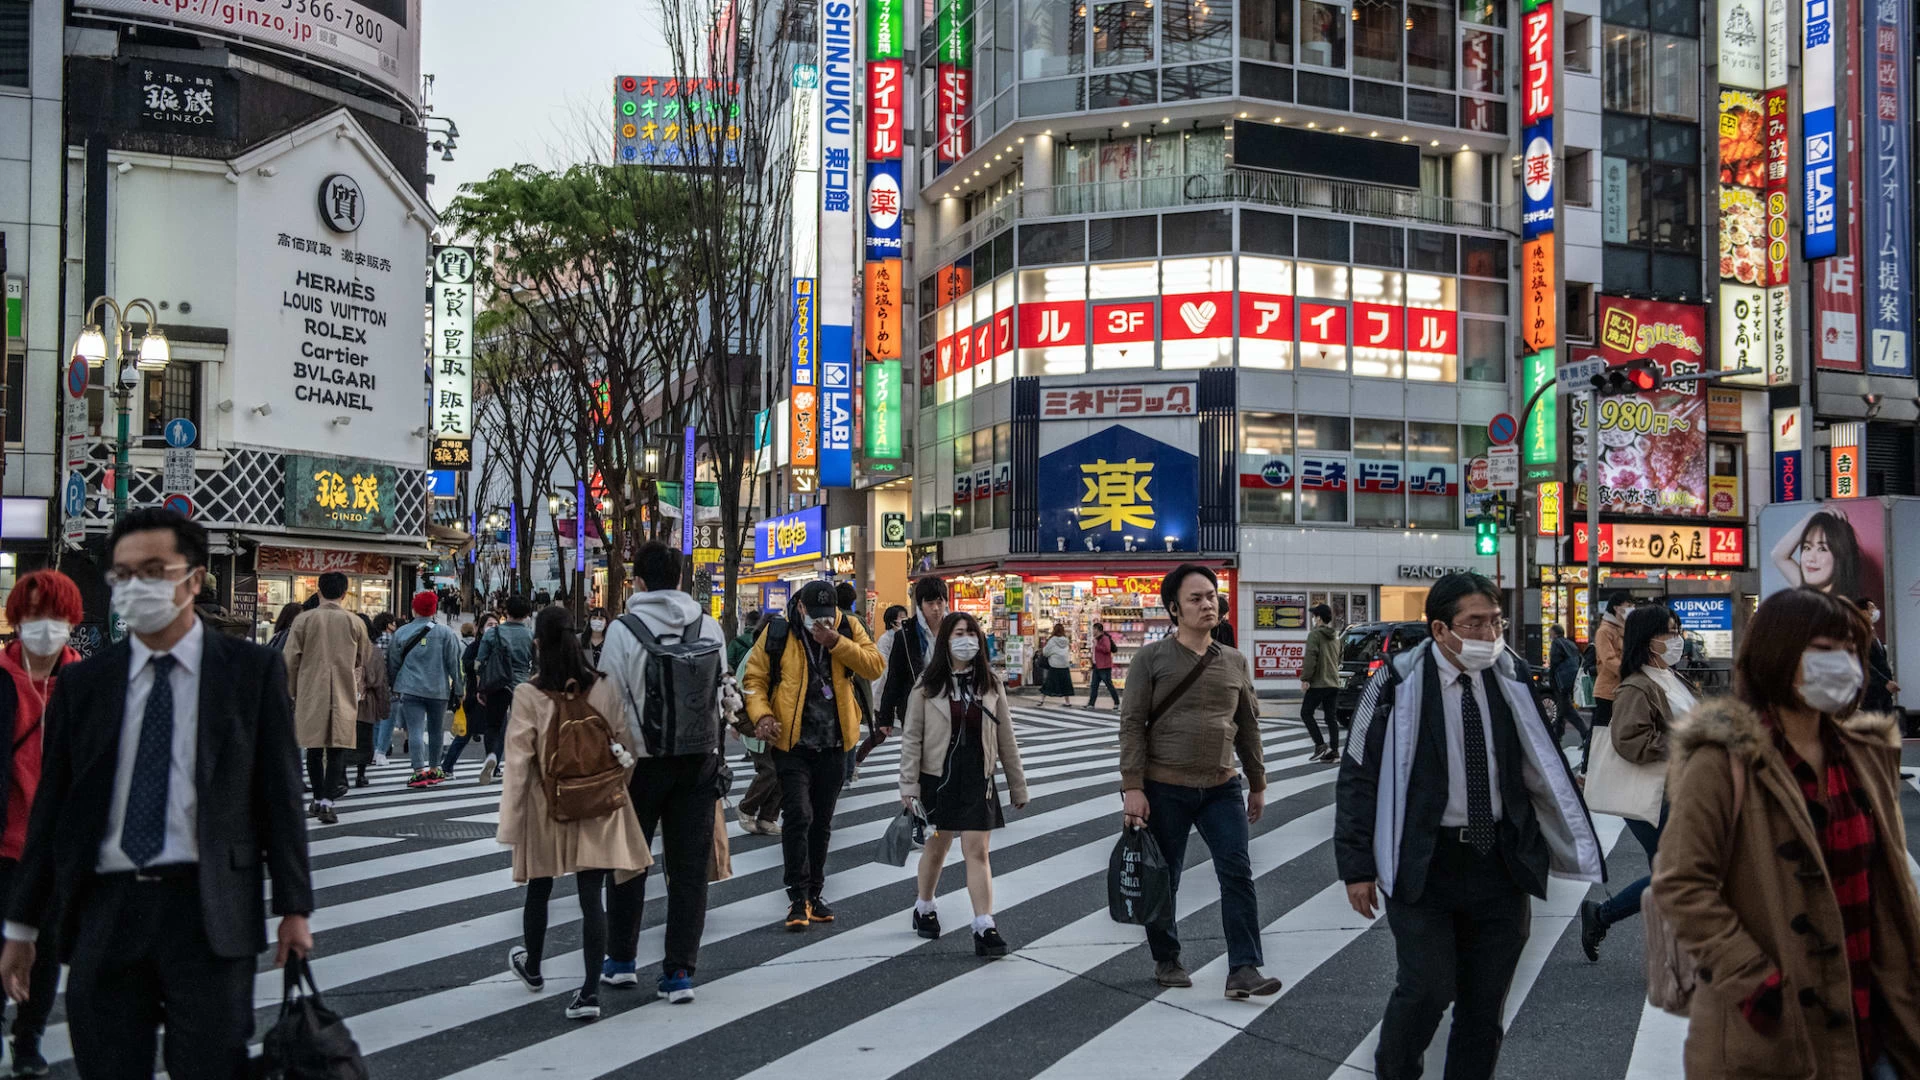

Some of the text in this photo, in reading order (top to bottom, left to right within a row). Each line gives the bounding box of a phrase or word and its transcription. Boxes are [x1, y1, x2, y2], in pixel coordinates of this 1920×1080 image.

[143, 0, 312, 41] p://ginzo.jp
[1529, 13, 1549, 116] アイフル
[1722, 55, 1760, 70] Rydia
[825, 2, 851, 212] SHINJUKU 東口館
[874, 67, 896, 153] アイフル
[1769, 97, 1787, 180] 飲み放題
[1527, 153, 1549, 187] 薬
[332, 183, 358, 225] 質
[871, 189, 897, 215] 薬
[1815, 166, 1834, 234] LABI
[278, 233, 392, 272] 高価買取 激安販売
[441, 252, 467, 279] 質
[296, 270, 375, 301] HERMÈS
[283, 290, 386, 327] LOUIS VUITTON
[1108, 310, 1144, 334] 3F
[1253, 301, 1447, 349] アイフル
[304, 318, 366, 344] ROLEX
[301, 341, 369, 367] Cartier
[293, 361, 376, 390] BVLGARI
[295, 385, 373, 411] CHANEL
[832, 392, 849, 449] LABI
[315, 470, 380, 514] 銀蔵
[1078, 458, 1156, 532] 薬
[1783, 456, 1795, 501] PROMI
[1649, 530, 1706, 561] 日高屋
[1716, 531, 1736, 551] 24
[1674, 600, 1724, 612] SUBNADE
[1259, 644, 1303, 656] Tax-free
[1279, 657, 1303, 669] Shop
